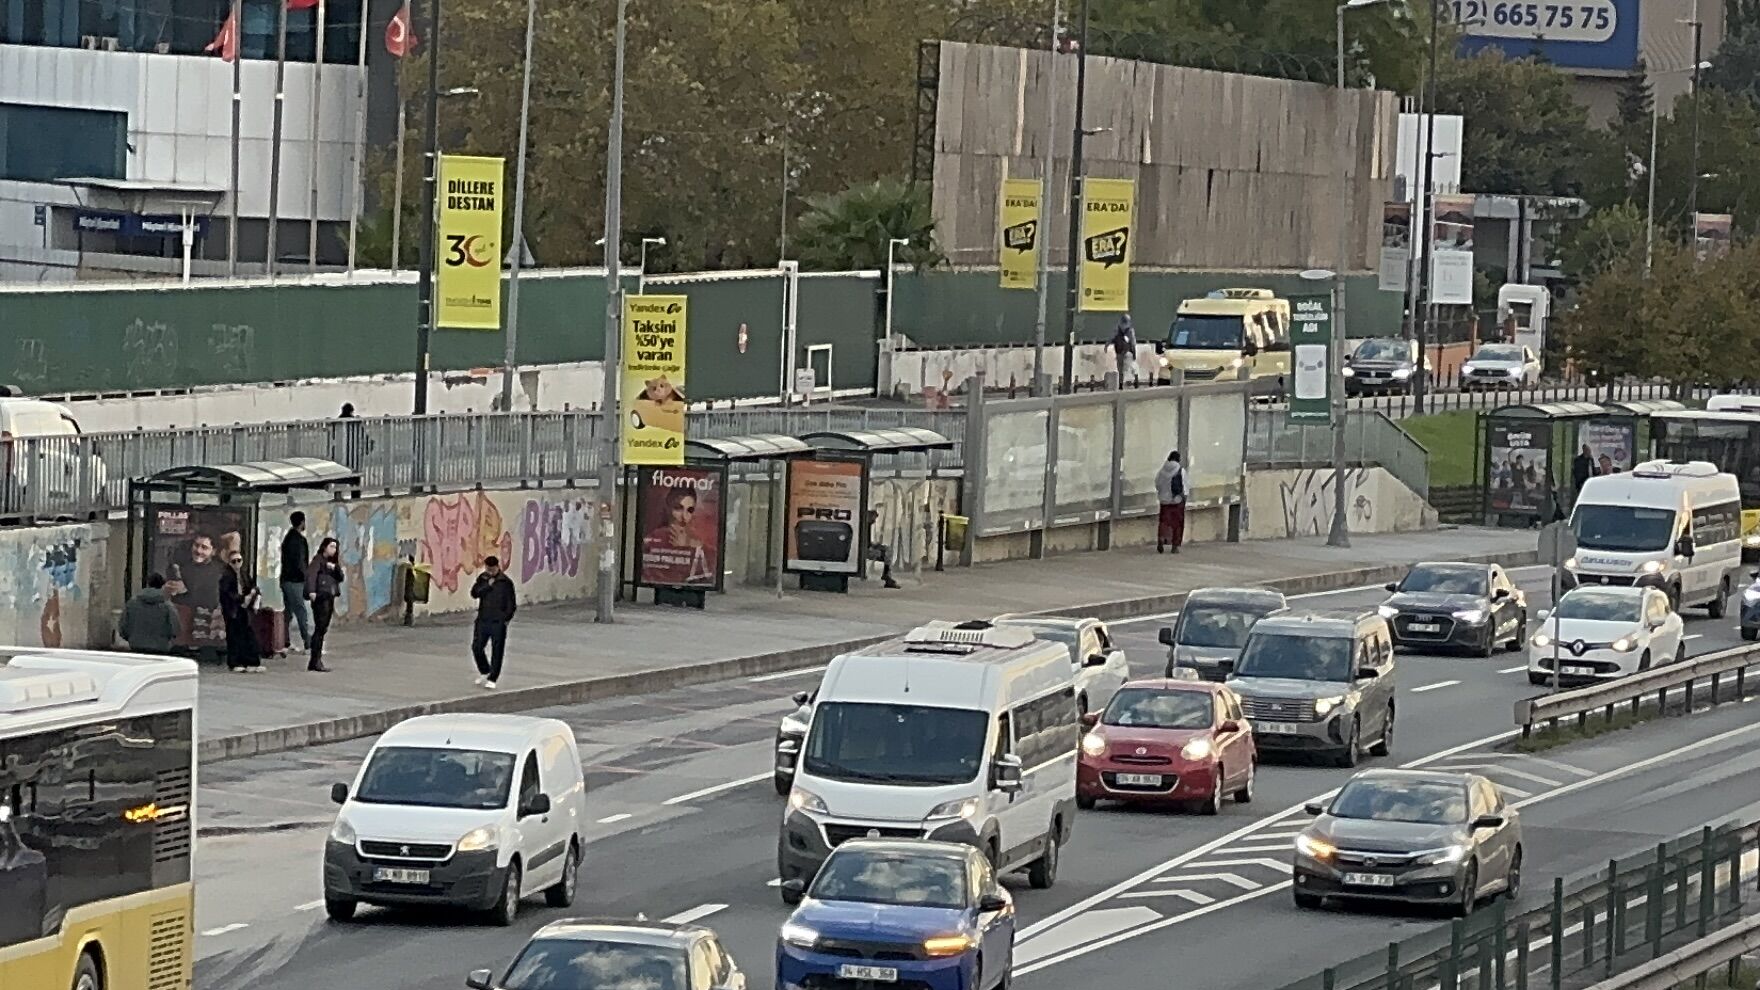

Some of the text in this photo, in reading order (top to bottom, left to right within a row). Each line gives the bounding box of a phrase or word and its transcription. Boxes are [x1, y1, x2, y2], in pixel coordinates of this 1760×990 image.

[1494, 3, 1538, 26] 665
[1545, 5, 1573, 28] 75
[1581, 7, 1609, 30] 75
[448, 178, 494, 196] DİLLERE
[448, 196, 494, 211] DESTAN
[630, 304, 665, 313] Yandex
[632, 320, 676, 334] Taksini
[635, 334, 674, 350] %50'ye
[637, 352, 672, 362] varan
[628, 439, 662, 448] Yandex
[652, 470, 714, 491] flormar
[797, 507, 851, 520] PRO
[844, 966, 852, 976] 34
